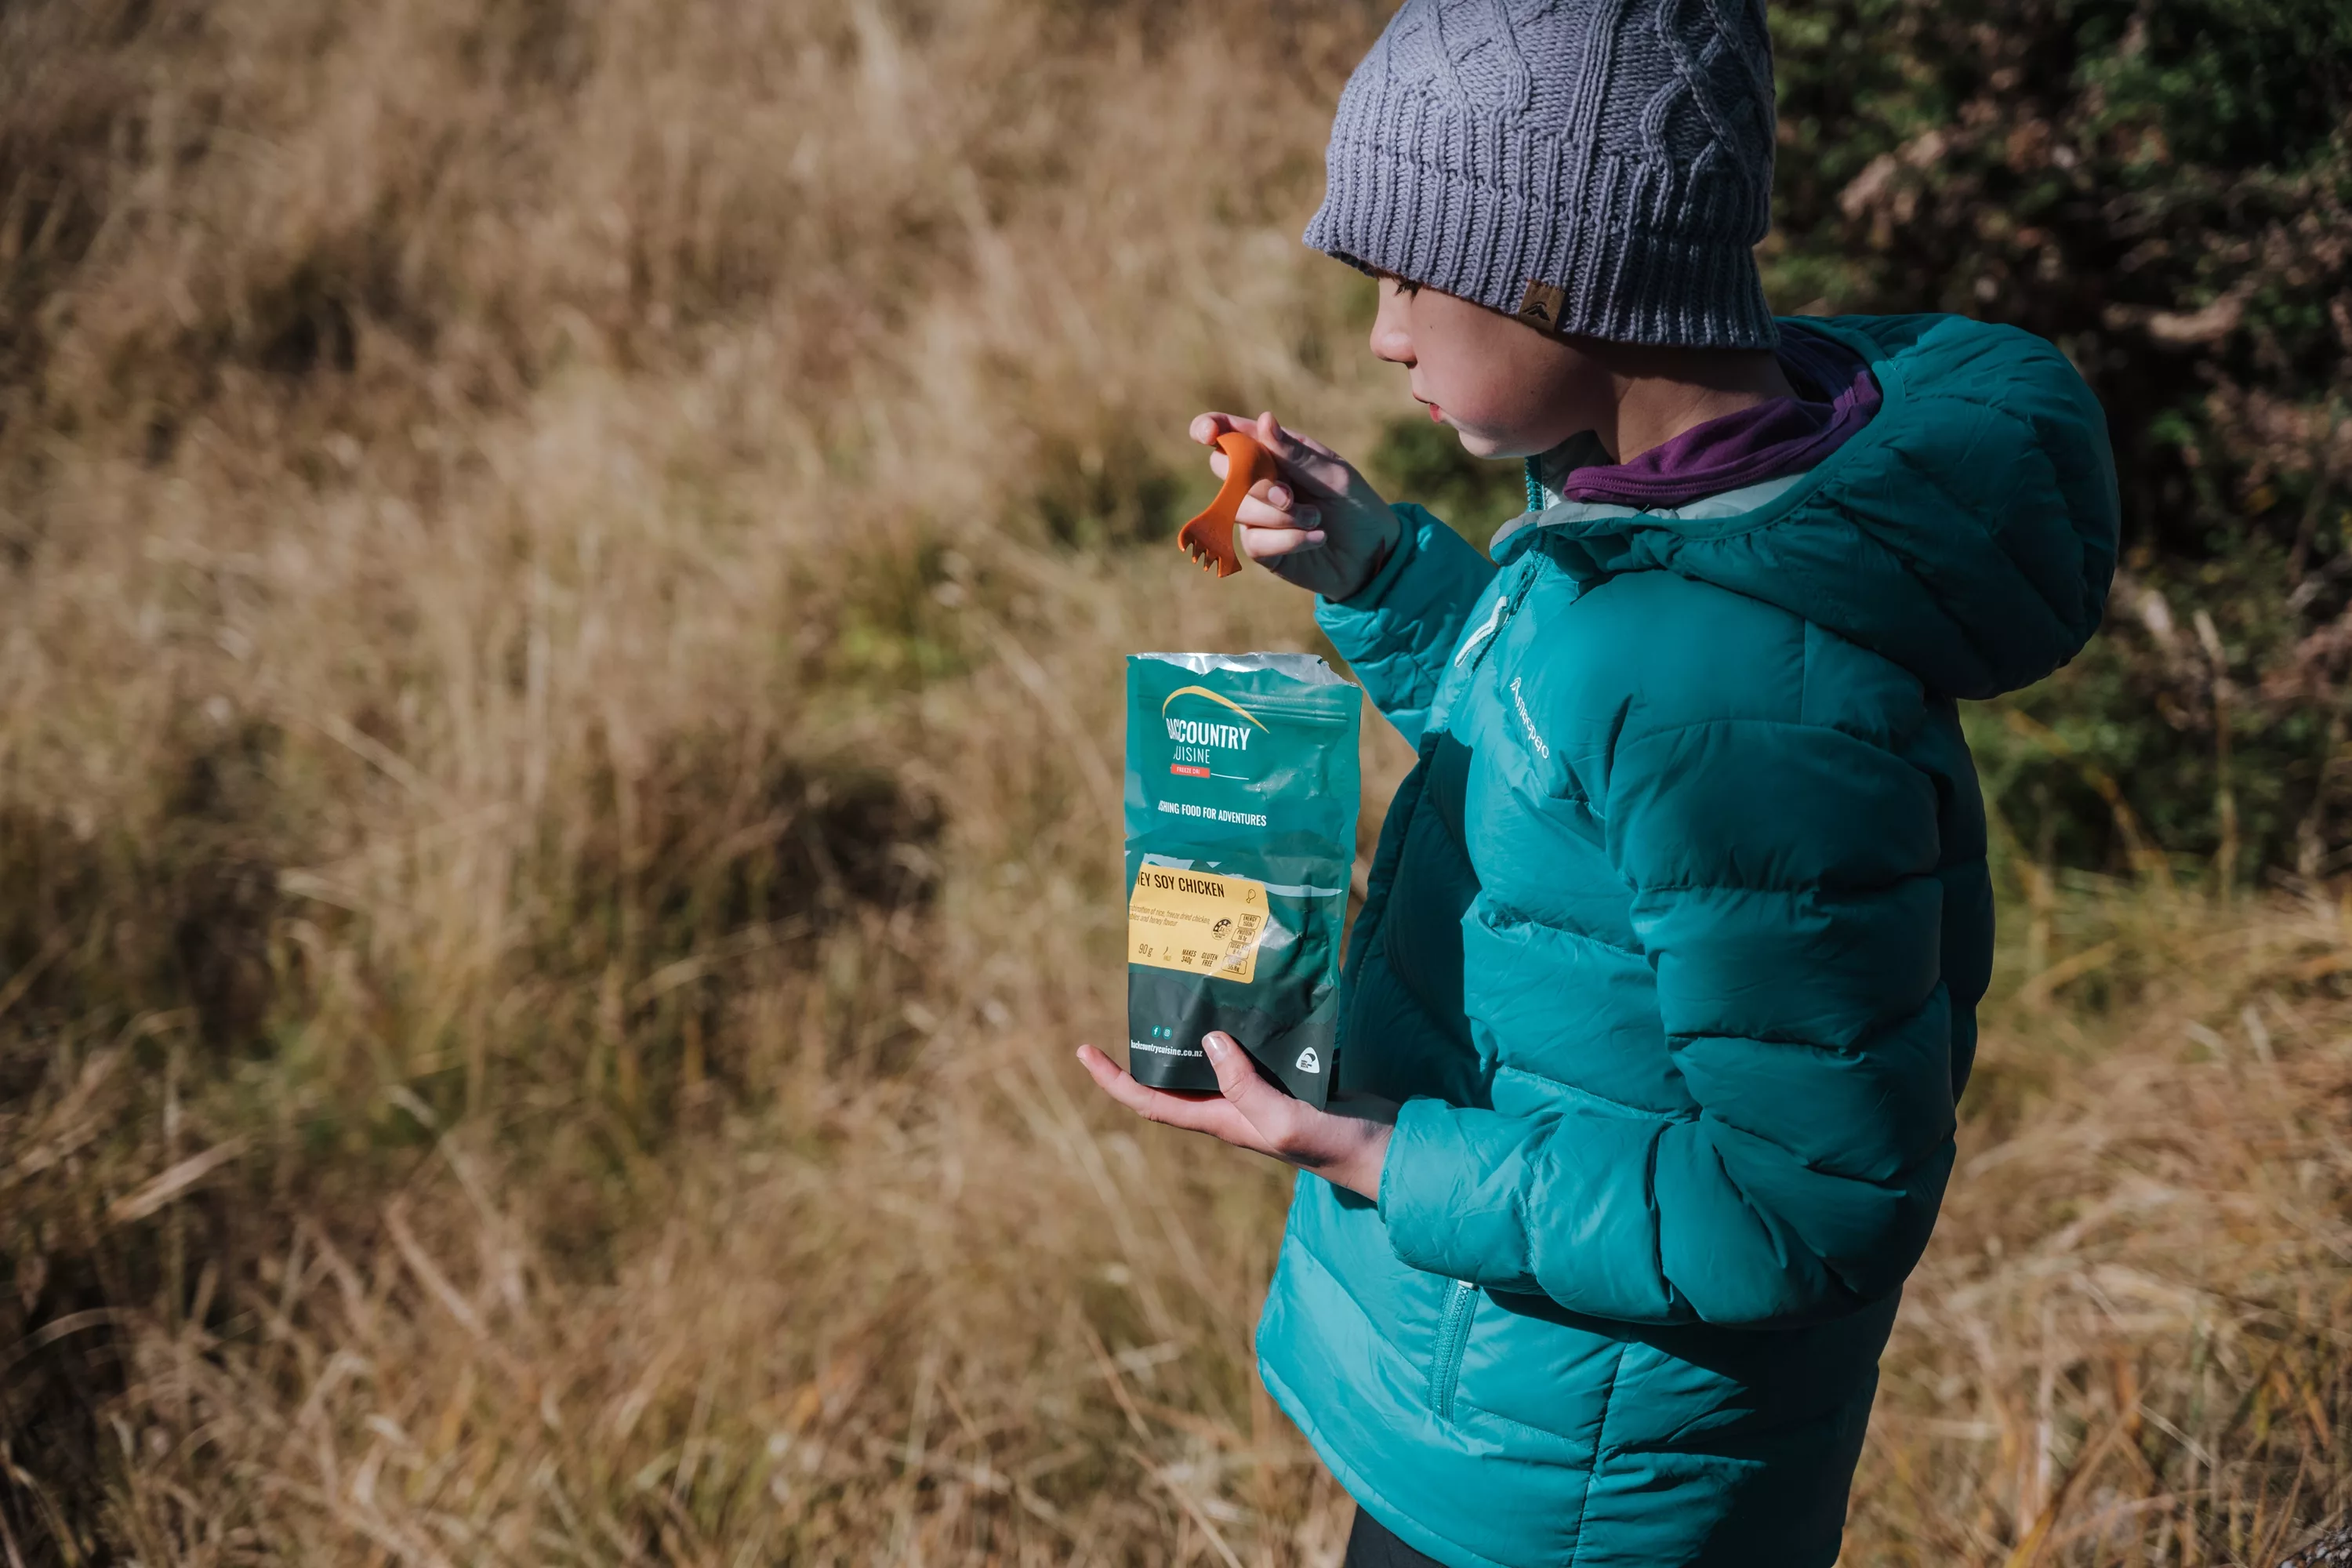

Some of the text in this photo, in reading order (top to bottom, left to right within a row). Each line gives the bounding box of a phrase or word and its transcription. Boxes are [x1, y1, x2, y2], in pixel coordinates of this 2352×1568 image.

[1515, 695, 1549, 760] macpac
[1173, 745, 1210, 764] UISINE
[1181, 804, 1201, 817] FOOD
[1203, 807, 1217, 819] FOR
[1218, 810, 1267, 827] ADVENTURES
[1154, 874, 1174, 890] SOY
[1178, 877, 1225, 898] CHICKEN
[1149, 916, 1163, 925] honey
[1166, 910, 1181, 920] freeze
[1180, 913, 1192, 921] dried
[1181, 949, 1197, 957] MAKES
[1201, 952, 1219, 960] GLUTEN
[1181, 956, 1192, 965] 340g
[1201, 959, 1214, 967] FREE
